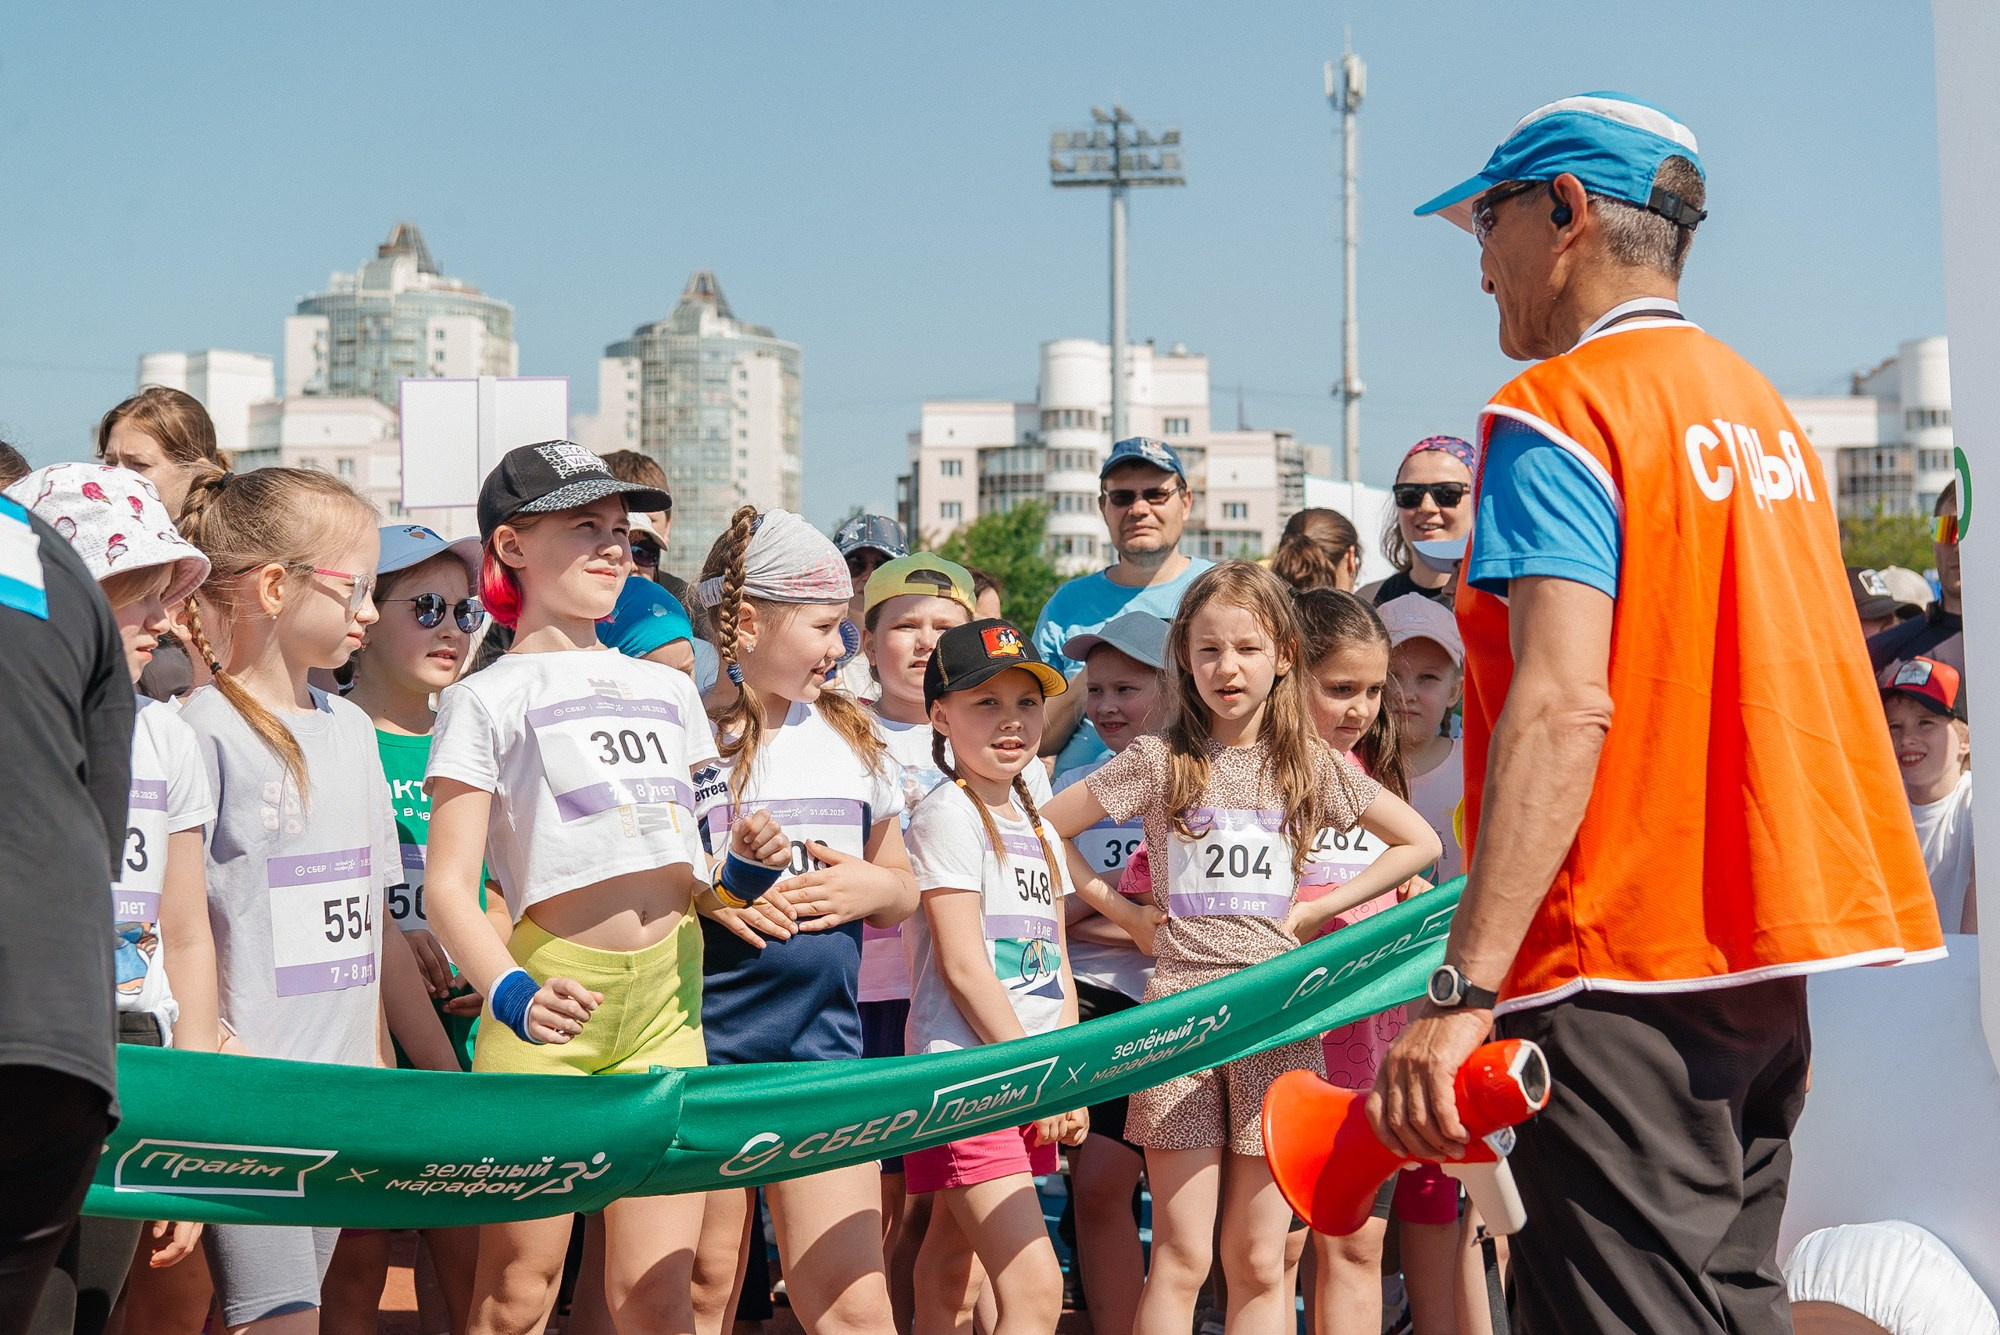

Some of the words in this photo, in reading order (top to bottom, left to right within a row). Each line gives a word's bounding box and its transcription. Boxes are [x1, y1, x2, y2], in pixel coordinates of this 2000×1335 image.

[558, 446, 589, 455] STAY
[568, 457, 600, 465] WILD
[590, 729, 668, 765] 301
[129, 789, 159, 800] 05.2025
[635, 783, 646, 798] 8
[809, 808, 846, 817] 31.05.2025
[126, 827, 149, 872] 3
[306, 864, 327, 874] СБЕР
[1205, 844, 1272, 880] 204
[1322, 866, 1332, 879] 7
[1014, 867, 1051, 906] 548
[119, 900, 146, 916] лет
[1207, 897, 1216, 911] 7
[1230, 896, 1239, 910] 8
[1242, 900, 1267, 911] лет
[323, 894, 372, 943] 554
[330, 966, 340, 984] 7
[351, 963, 359, 980] 8
[1111, 1016, 1196, 1060] зелёный
[1090, 1045, 1178, 1083] марафон
[936, 1082, 1029, 1122] Прайм
[788, 1109, 918, 1159] СБЕР
[140, 1151, 285, 1178] Прайм
[419, 1156, 556, 1178] зелёный
[384, 1178, 527, 1198] марафон
